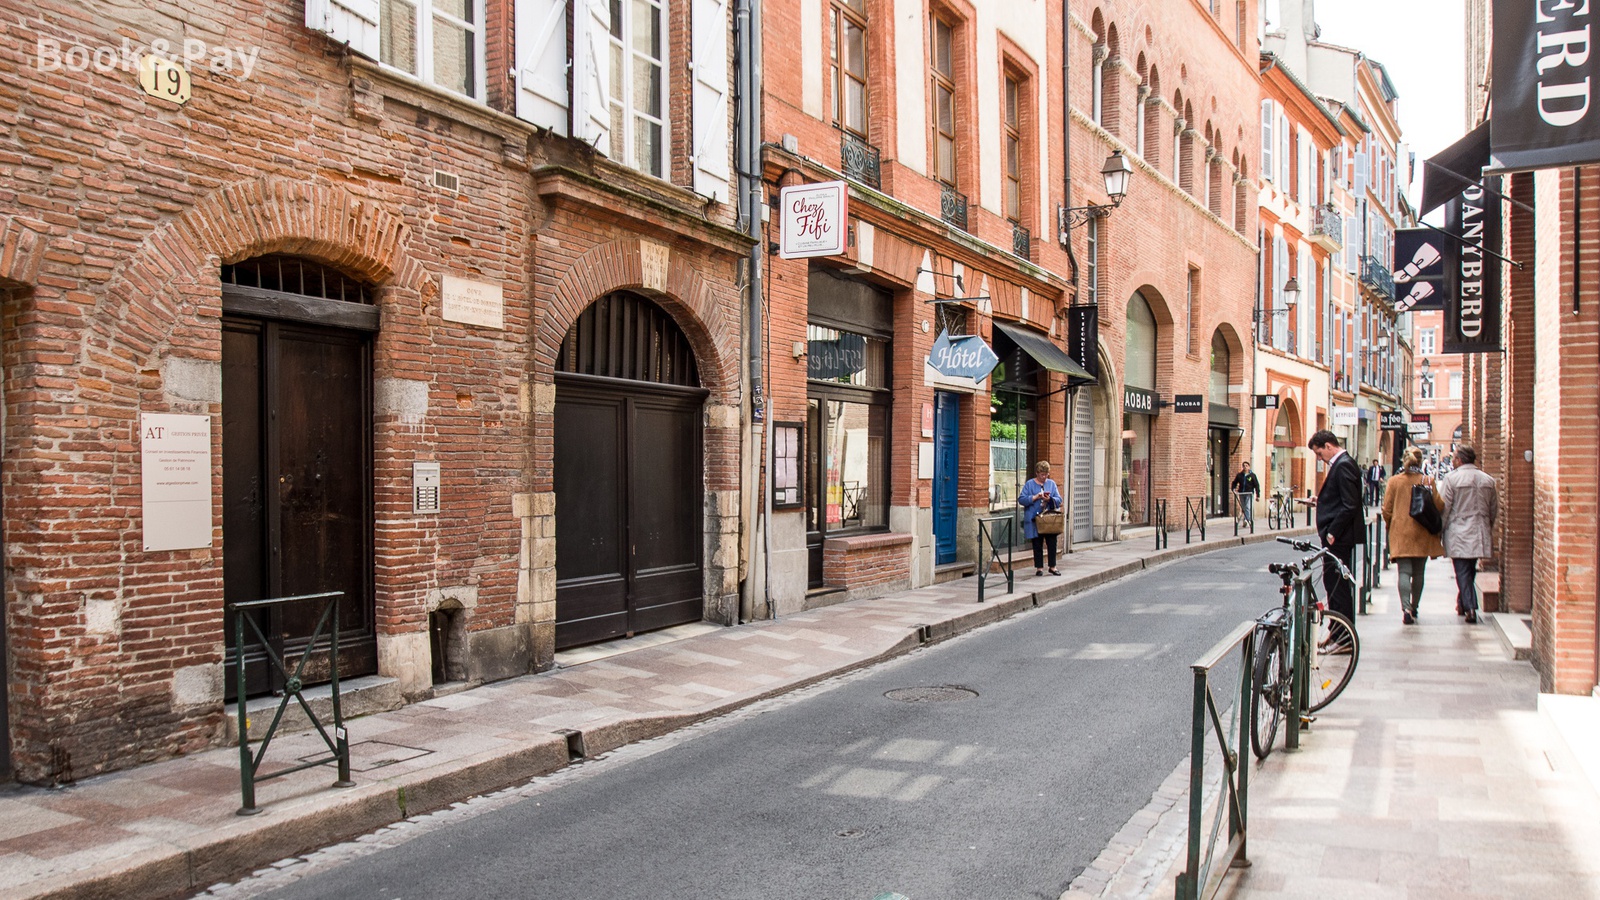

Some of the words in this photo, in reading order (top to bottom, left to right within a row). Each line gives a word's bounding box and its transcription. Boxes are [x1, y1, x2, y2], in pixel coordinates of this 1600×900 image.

[792, 197, 824, 218] Chez
[796, 208, 831, 240] Fifi
[937, 343, 986, 369] Hôtel
[145, 426, 165, 440] AT
